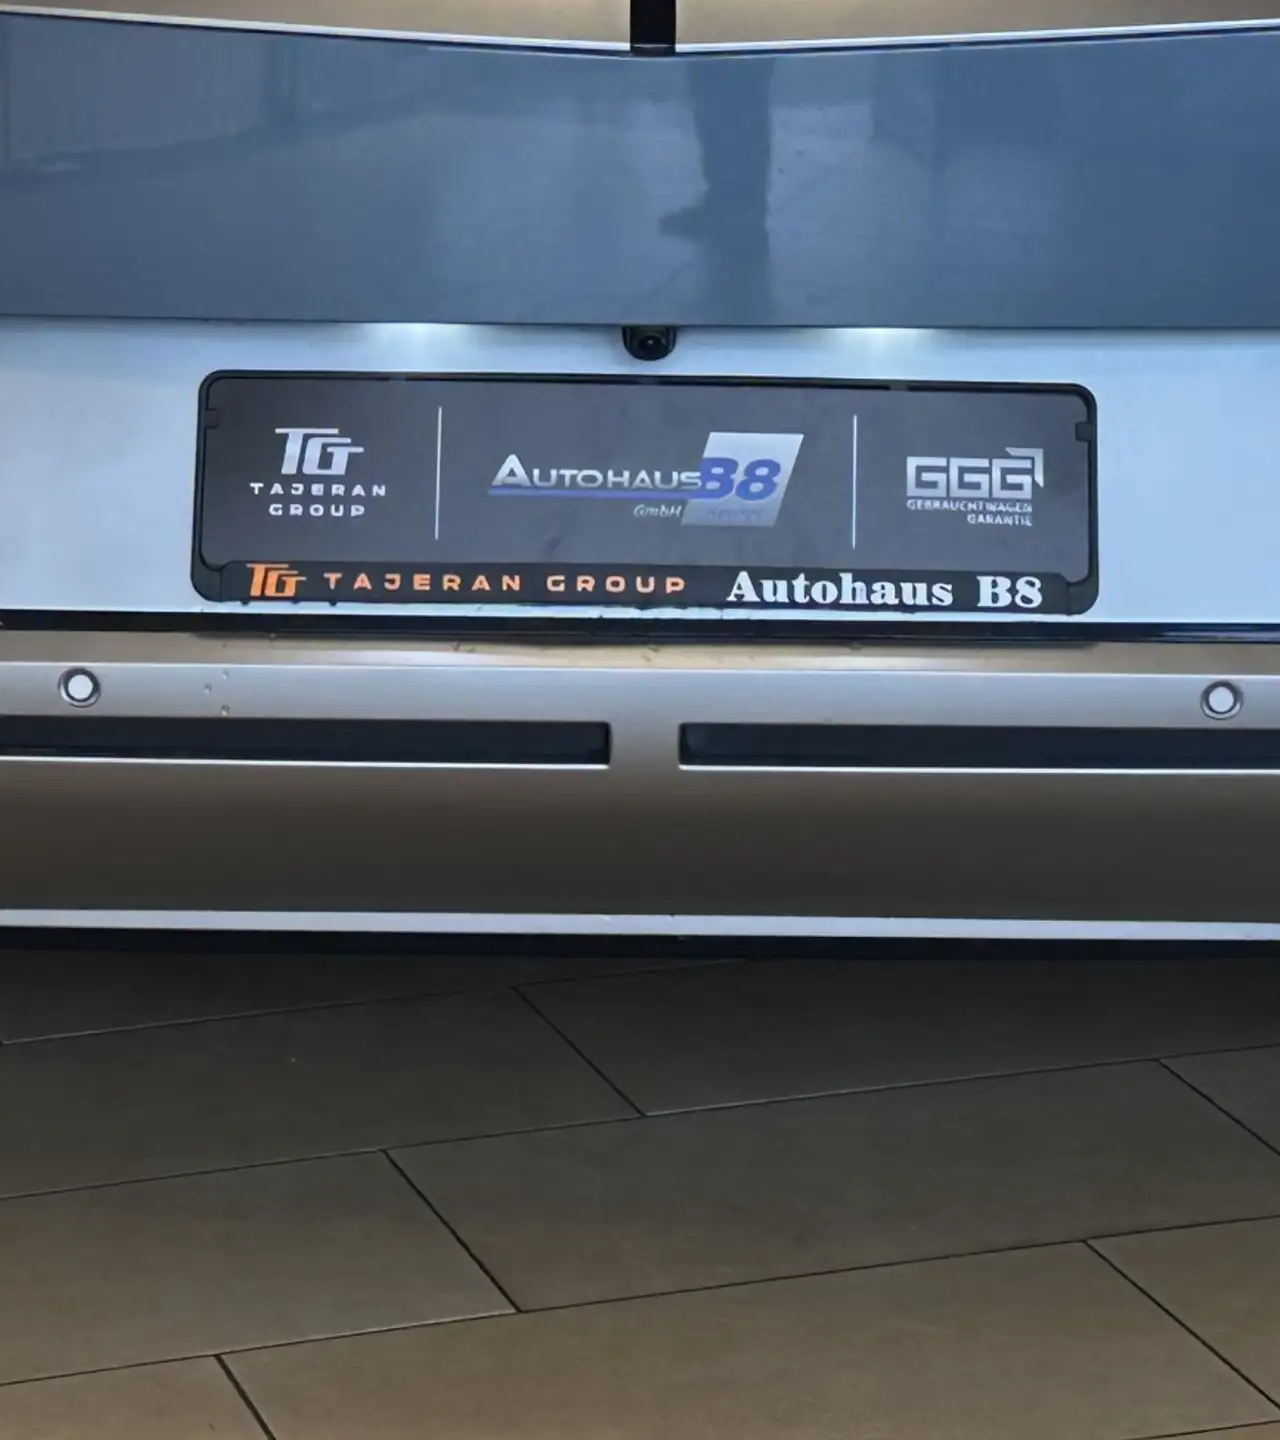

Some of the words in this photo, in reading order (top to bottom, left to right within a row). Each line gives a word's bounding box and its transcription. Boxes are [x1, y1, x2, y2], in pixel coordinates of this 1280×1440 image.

[906, 456, 1033, 500] GGG
[249, 482, 387, 498] TAJERAN
[268, 503, 366, 517] GROUP
[633, 503, 682, 518] GmbH
[966, 512, 1033, 527] GARANTIE
[323, 571, 522, 592] TAJERAN
[545, 574, 687, 594] GROUP
[726, 570, 954, 607] Autohaus
[976, 575, 1043, 609] B8
